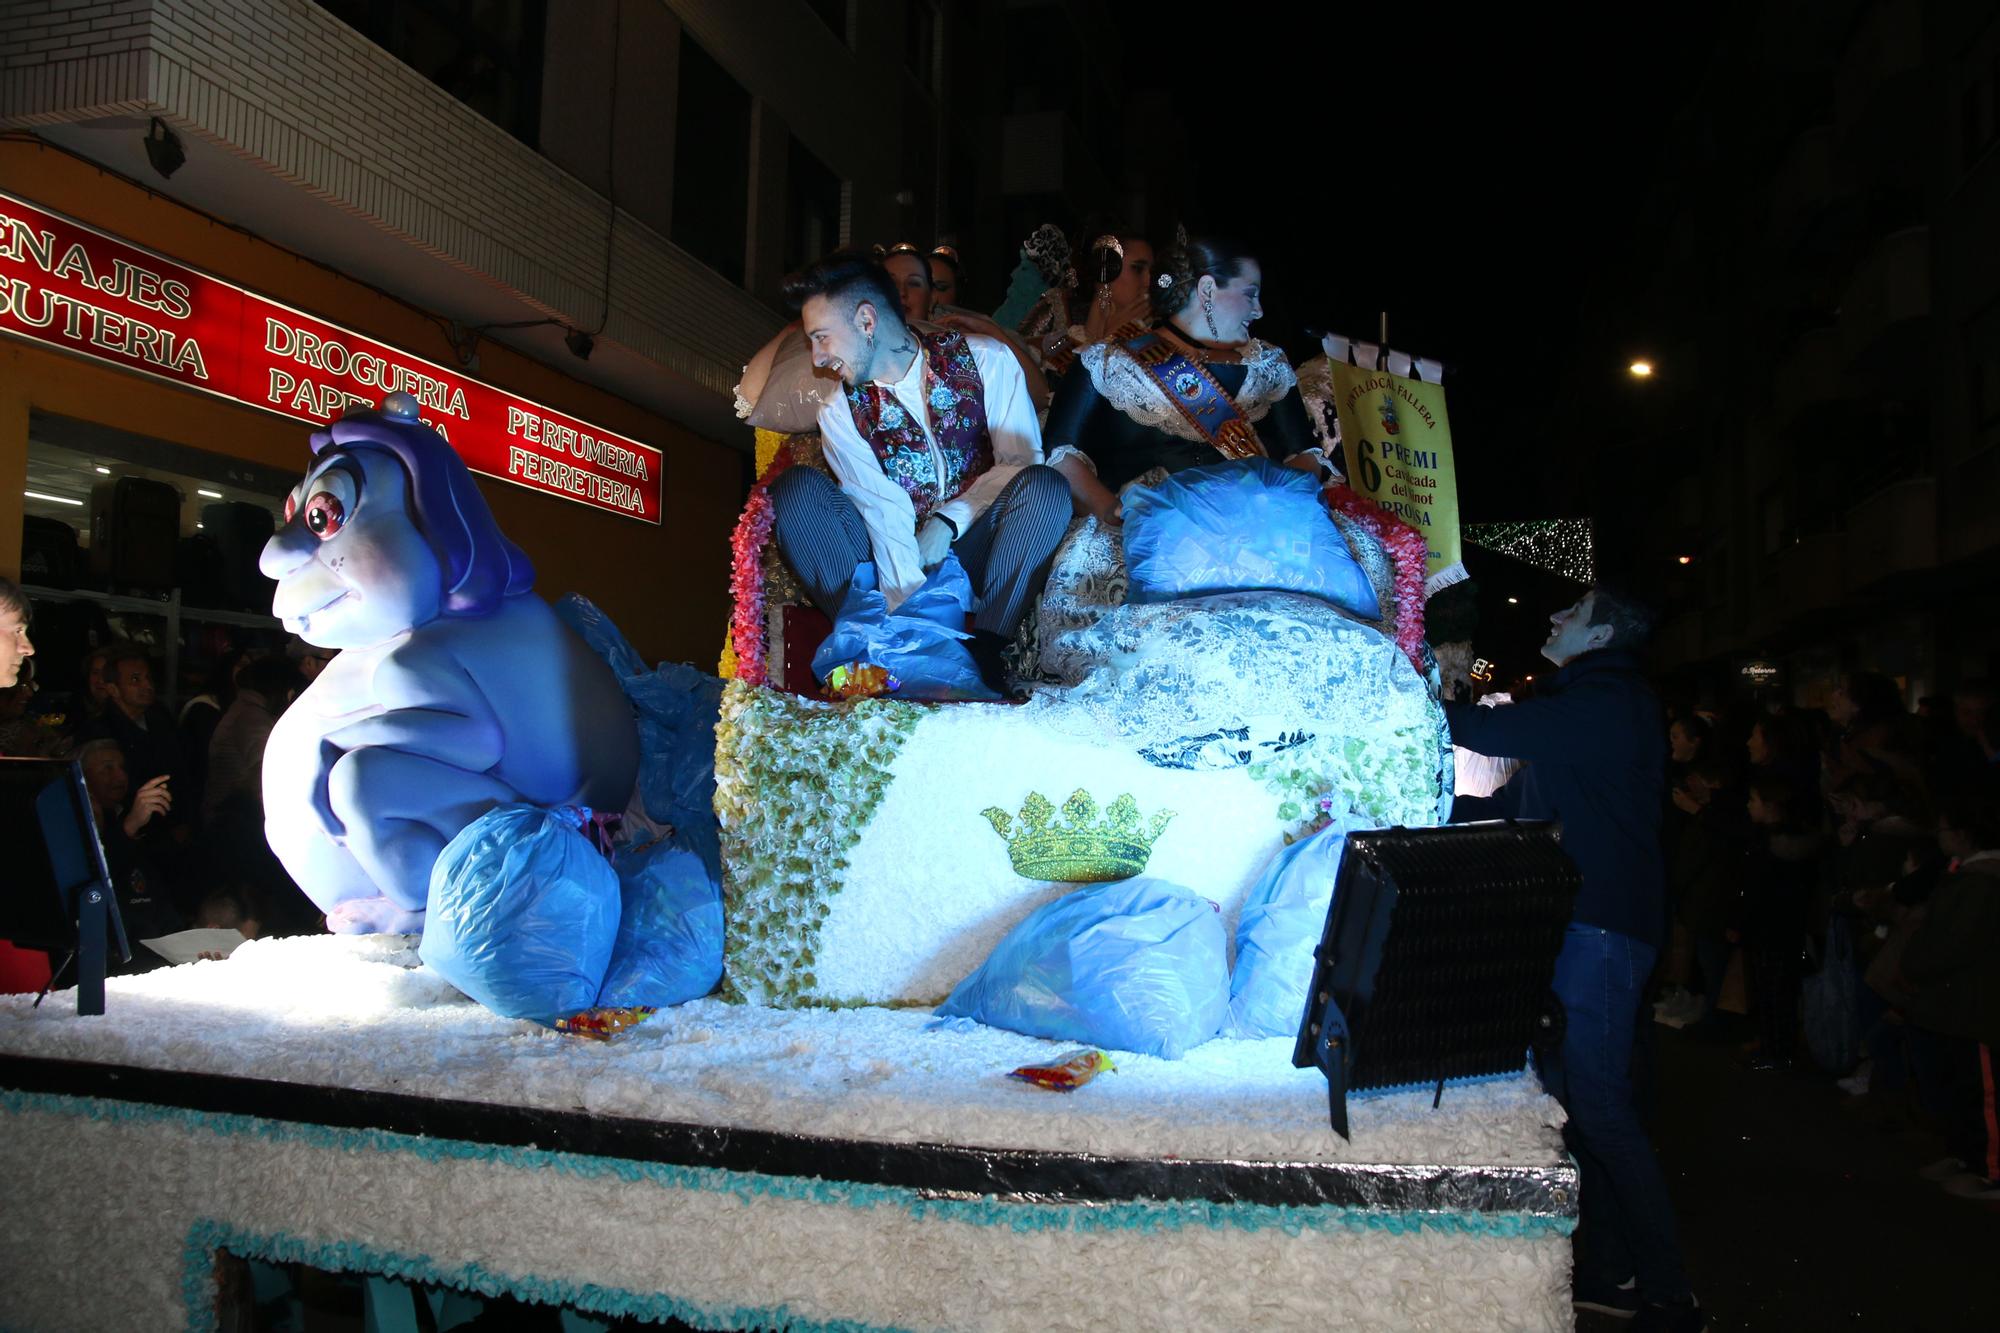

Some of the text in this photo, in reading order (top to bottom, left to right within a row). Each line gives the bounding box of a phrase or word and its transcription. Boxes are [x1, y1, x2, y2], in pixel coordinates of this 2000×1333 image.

[265, 317, 470, 420] DROGUERIA
[1397, 385, 1436, 429] FALLERA
[507, 406, 649, 482] PERFUMERIA
[1358, 439, 1381, 493] 6
[1381, 441, 1438, 469] PREMI
[508, 446, 645, 514] FERRETERIA
[1391, 483, 1408, 497] del
